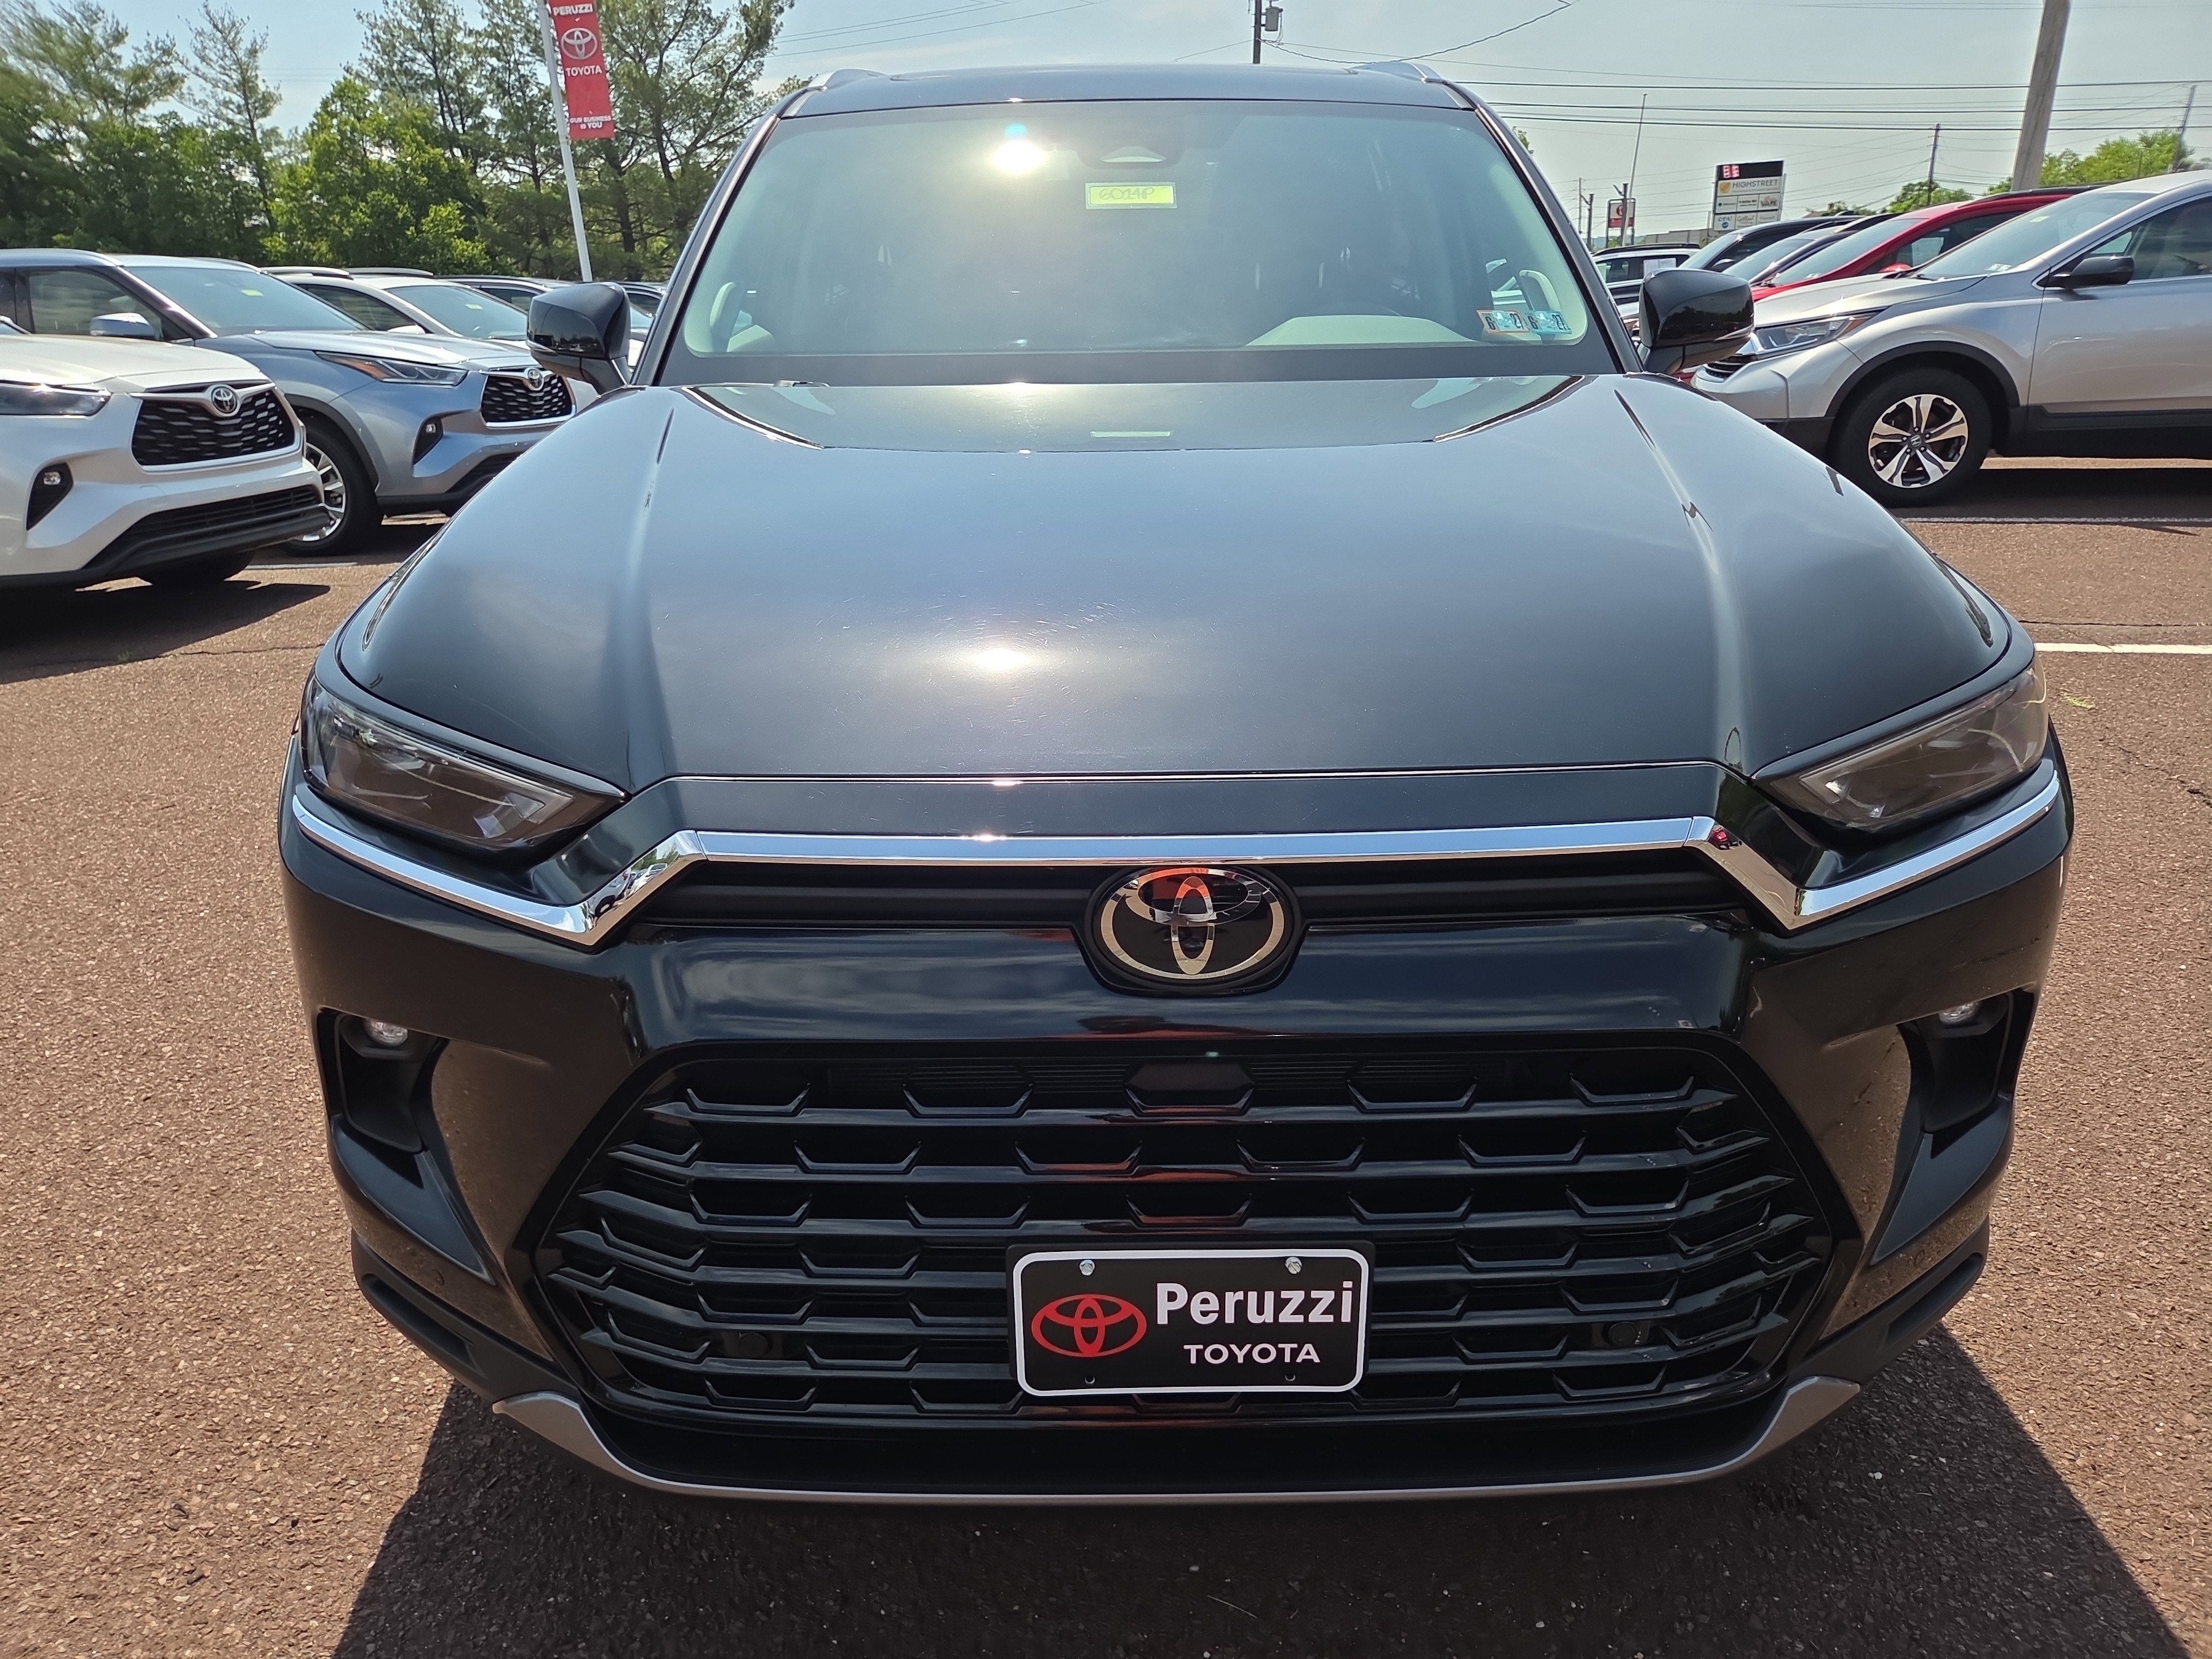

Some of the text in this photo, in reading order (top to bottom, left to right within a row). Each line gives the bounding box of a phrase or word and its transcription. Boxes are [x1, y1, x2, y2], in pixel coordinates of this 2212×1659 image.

[553, 3, 593, 16] PERUZZI
[565, 65, 602, 77] TOYOTA
[587, 121, 603, 130] YOU
[1485, 316, 1496, 330] 6
[1527, 316, 1539, 330] 6
[1156, 1281, 1354, 1324] Peruzzi
[1184, 1343, 1320, 1364] TOYOTA
